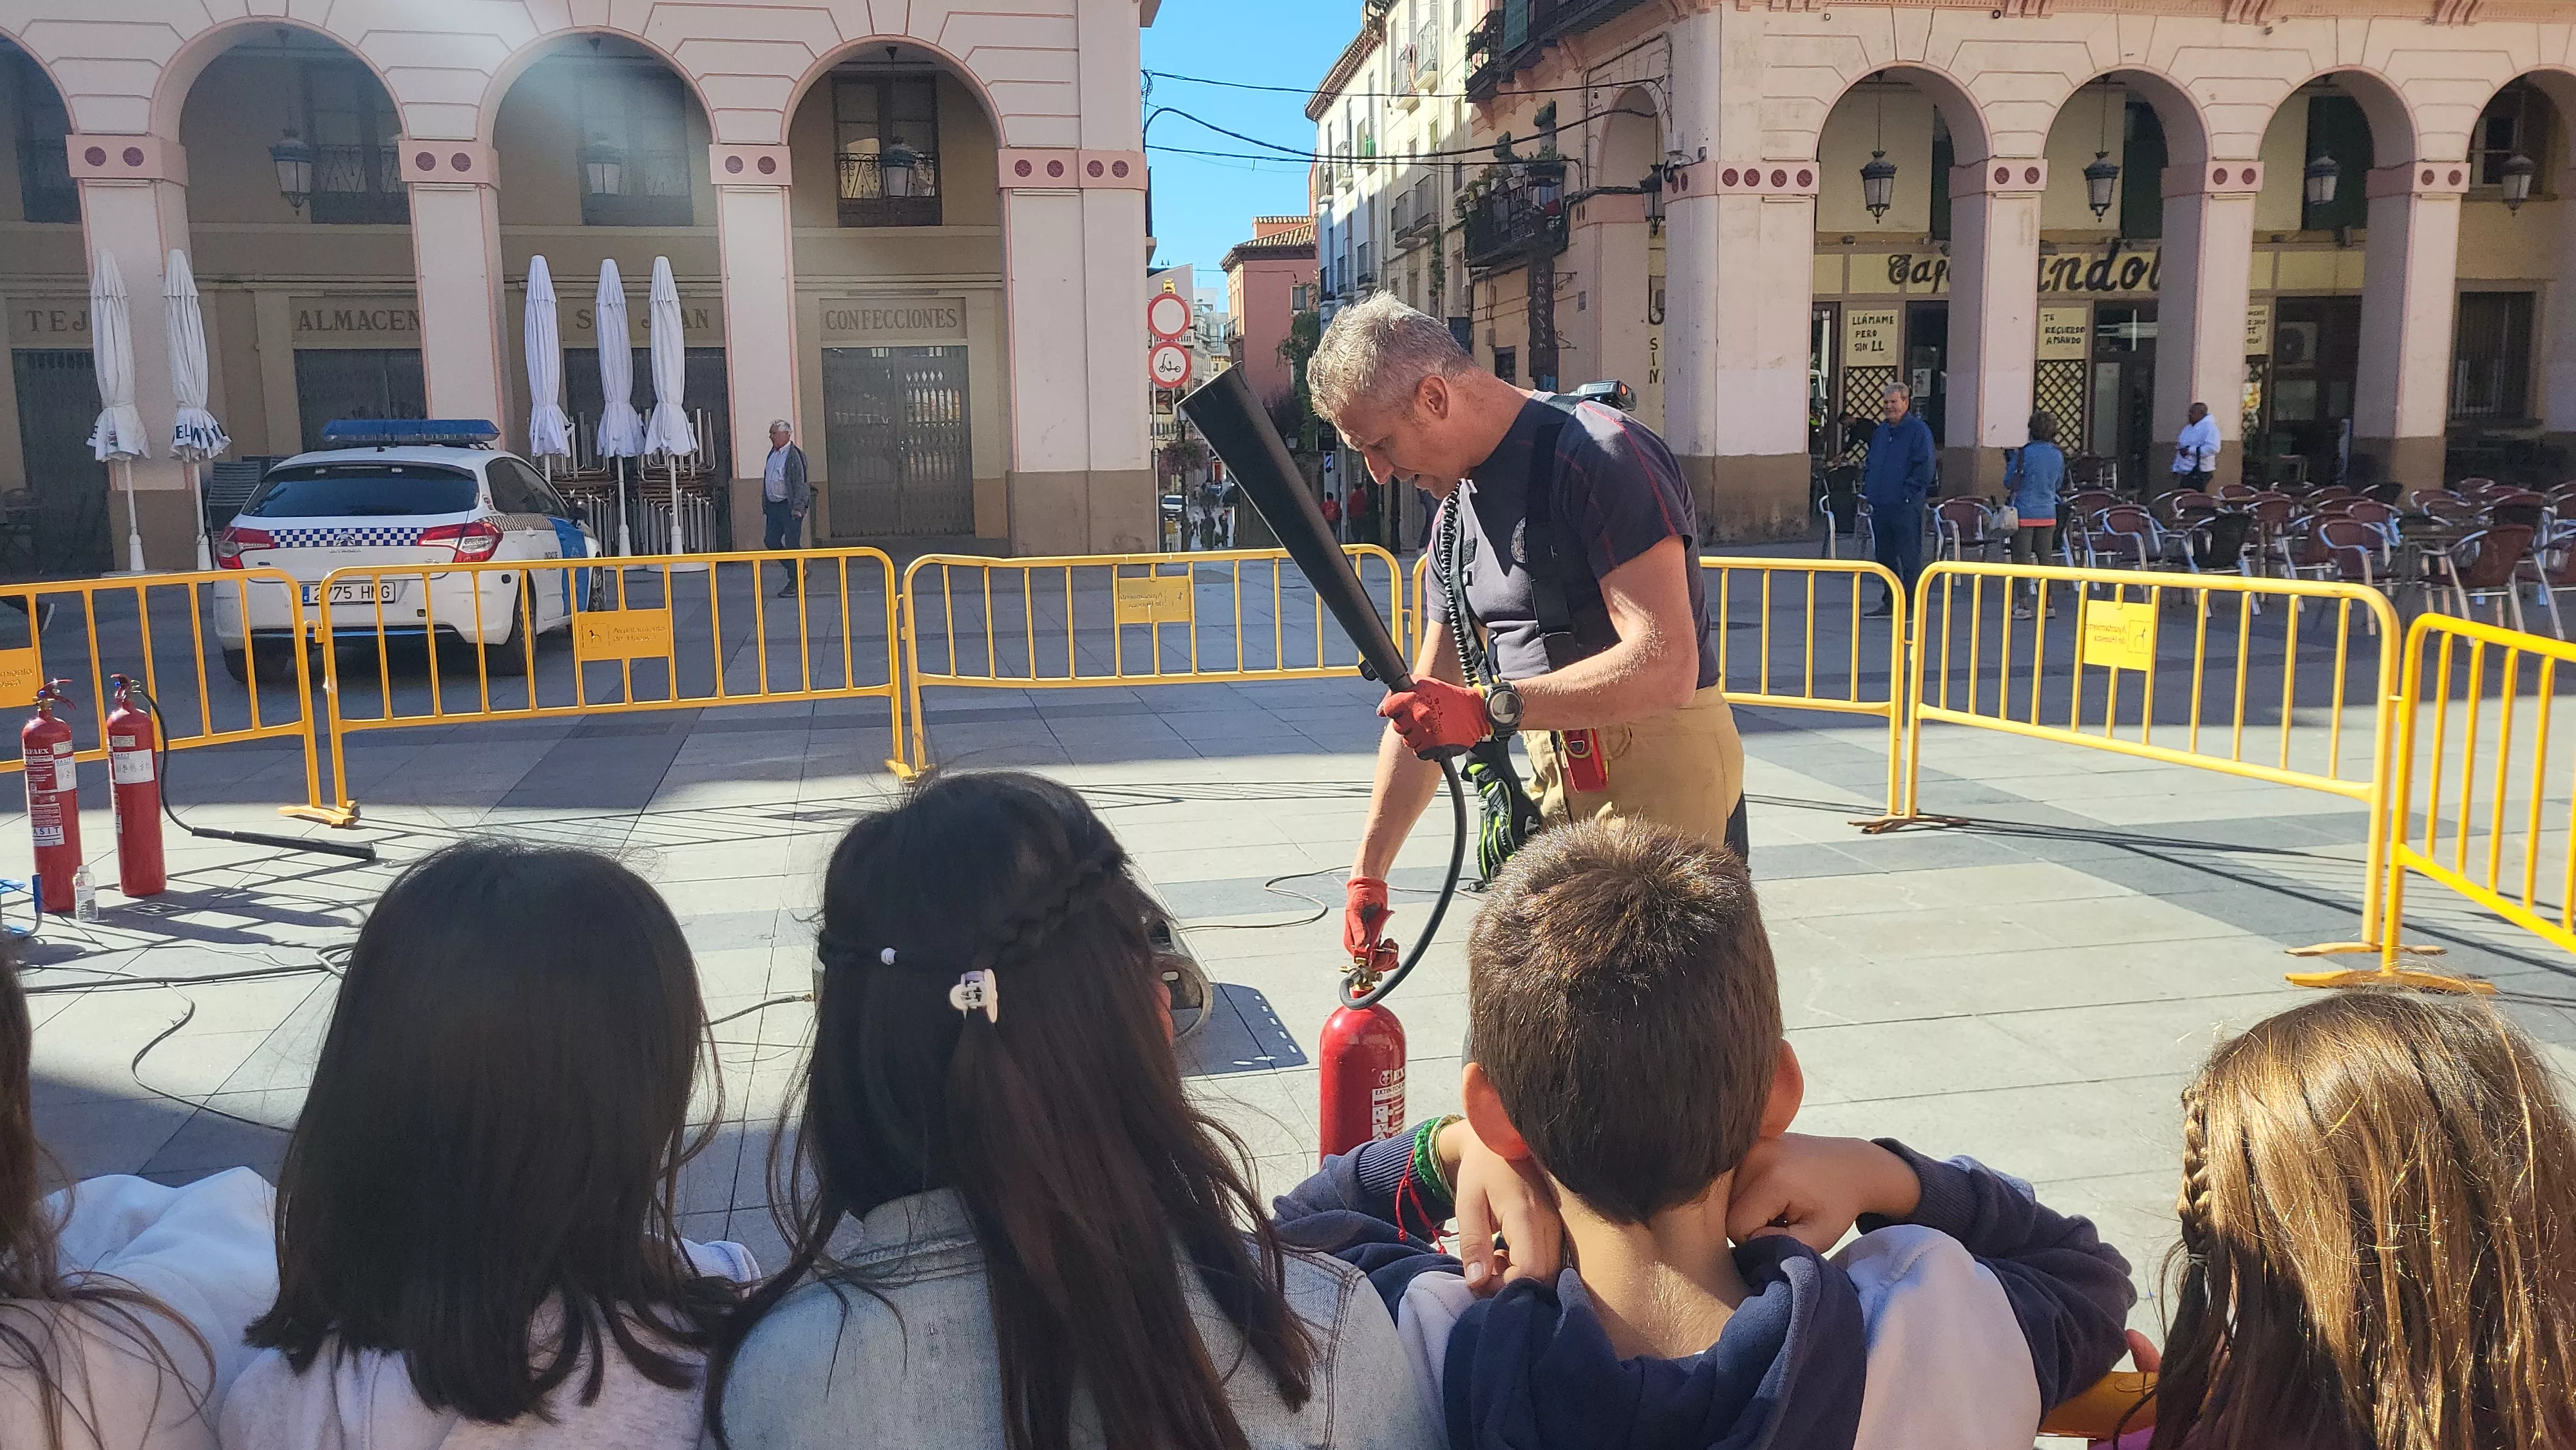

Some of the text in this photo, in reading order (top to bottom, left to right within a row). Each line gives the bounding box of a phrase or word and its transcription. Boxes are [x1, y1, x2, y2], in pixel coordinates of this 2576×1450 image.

[25, 310, 88, 332] TEJ
[826, 308, 958, 330] CONFECCIONES
[1852, 313, 1895, 325] LLÁMAME
[1855, 329, 1877, 338] PERO
[1854, 340, 1884, 352] SIN LL
[2046, 336, 2081, 345] AMANDO
